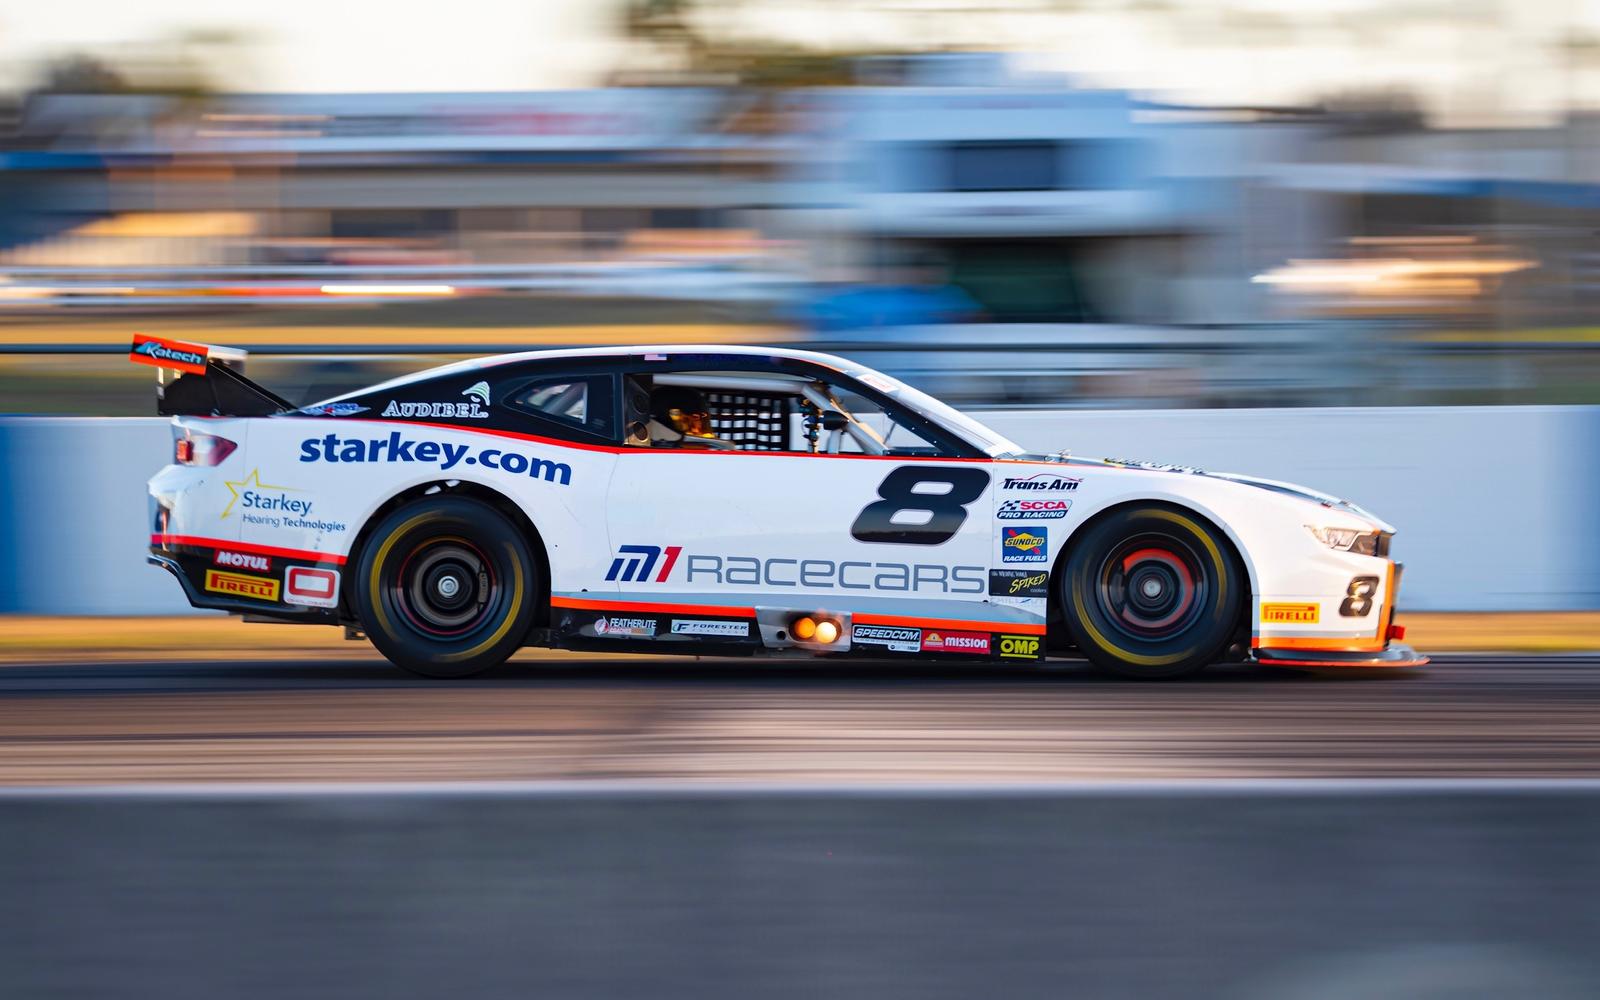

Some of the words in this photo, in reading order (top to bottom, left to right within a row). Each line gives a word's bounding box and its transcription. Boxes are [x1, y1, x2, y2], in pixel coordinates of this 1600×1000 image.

[143, 341, 202, 365] Katech
[300, 431, 572, 486] starkey.com
[1003, 478, 1048, 490] Trans
[1048, 479, 1079, 490] Am
[242, 491, 312, 517] Starkey
[850, 465, 992, 545] 8
[1020, 501, 1067, 510] SCCA
[242, 513, 280, 528] Hearing
[283, 516, 346, 531] Technologies
[1005, 537, 1044, 546] SUNOCO
[217, 551, 270, 570] MOTUL
[605, 545, 683, 583] M1
[210, 573, 275, 598] PIRELLI
[1008, 573, 1047, 594] SPIKED
[1339, 575, 1380, 618] 8
[1264, 605, 1315, 620] PIRELLI
[609, 618, 657, 629] FEATHERLITE
[854, 628, 919, 641] SPEEDCOM
[1000, 639, 1040, 655] OMP
